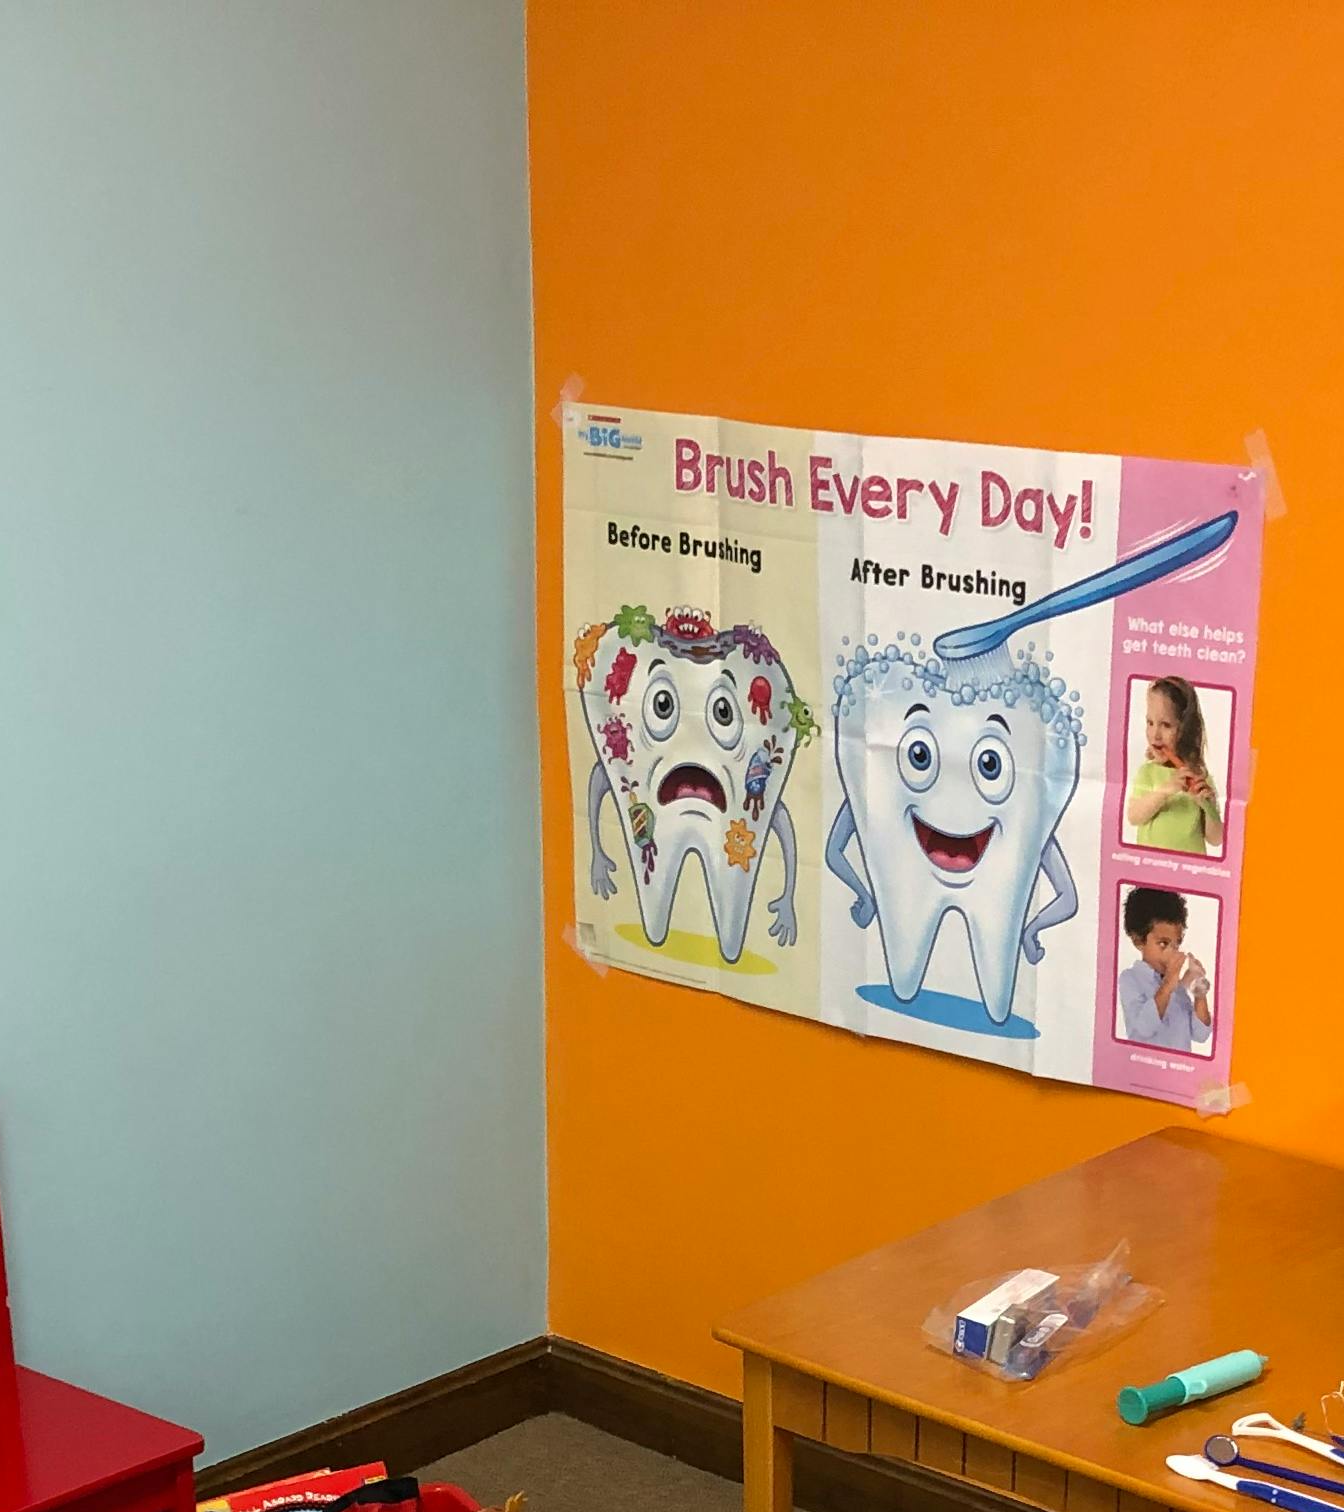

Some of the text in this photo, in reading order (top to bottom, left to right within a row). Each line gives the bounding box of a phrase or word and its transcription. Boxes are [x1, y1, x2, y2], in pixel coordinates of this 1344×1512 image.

[674, 438, 1093, 549] Brush Every Day!
[608, 521, 762, 573] Before Brushing
[851, 558, 1026, 606] After Brushing
[1123, 639, 1246, 664] get teeth clean?
[1127, 616, 1244, 644] What else helps
